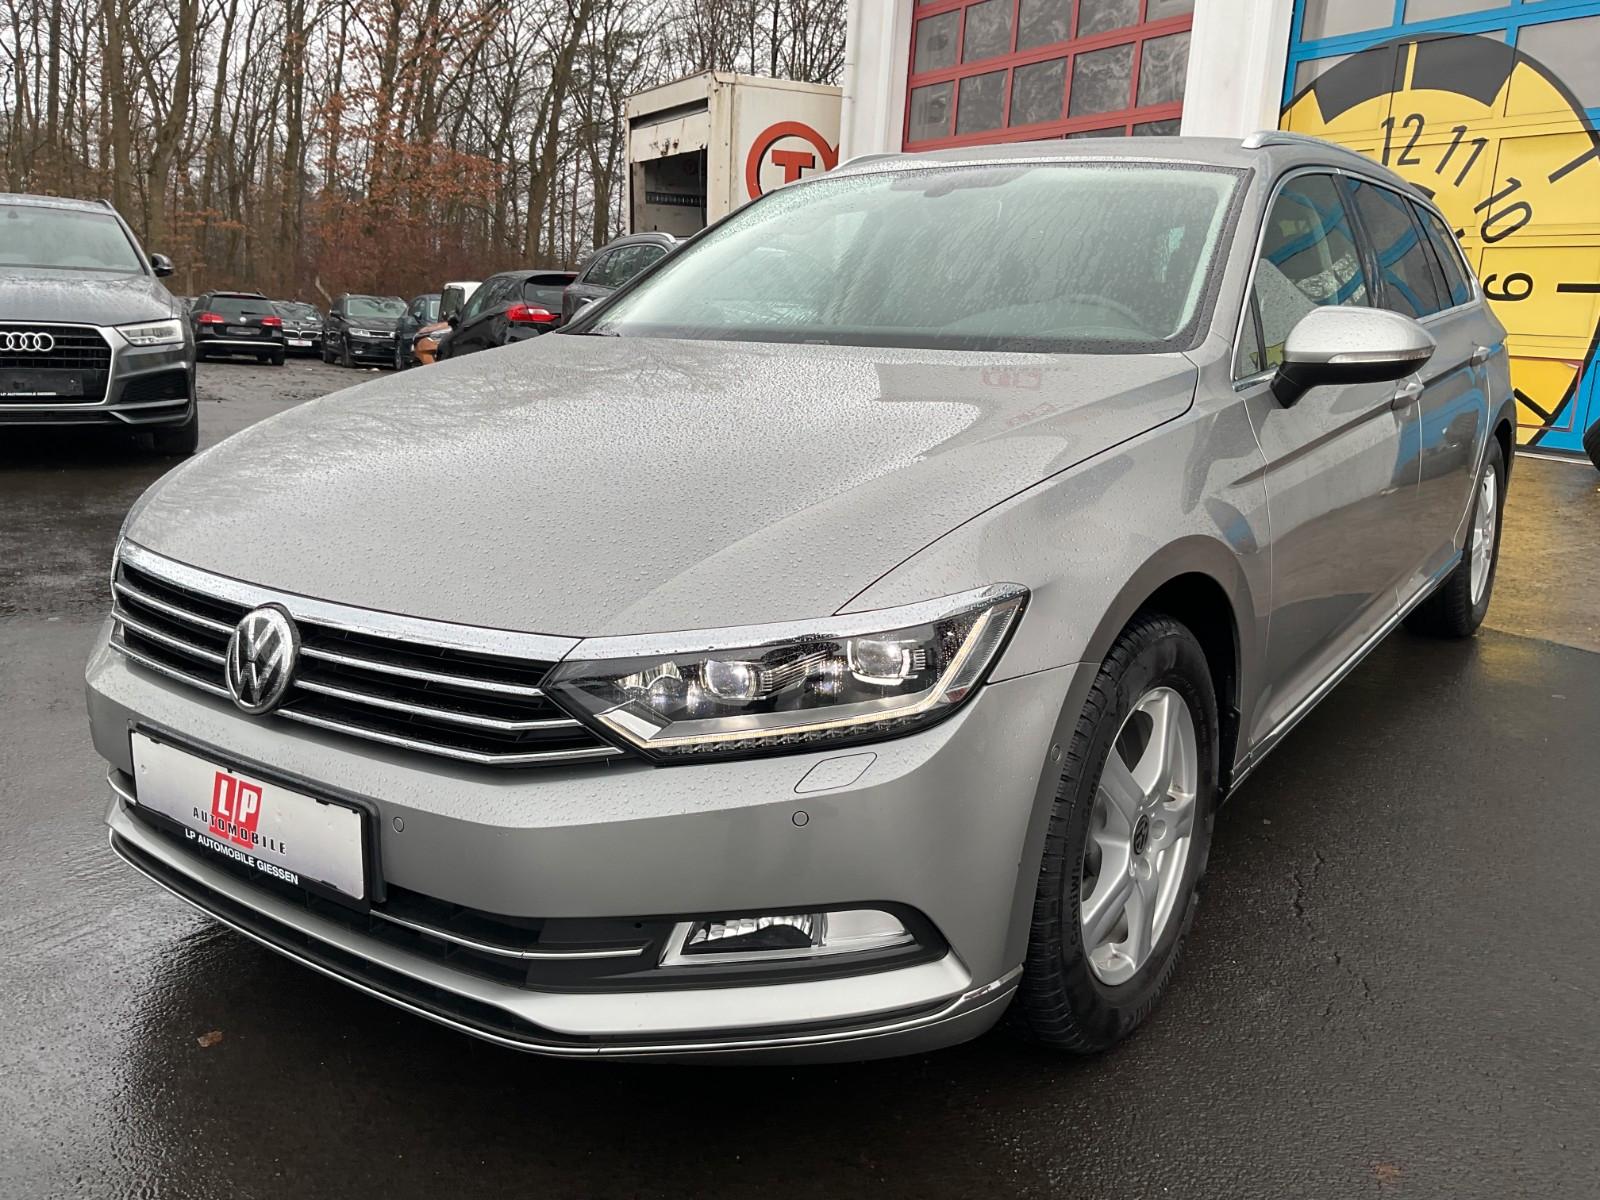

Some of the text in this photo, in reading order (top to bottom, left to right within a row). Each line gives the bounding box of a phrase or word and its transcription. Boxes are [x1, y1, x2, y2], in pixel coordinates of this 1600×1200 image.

[1380, 113, 1425, 167] 12
[1435, 125, 1490, 188] 11
[1473, 176, 1533, 244] 10
[217, 778, 259, 823] LP
[185, 828, 299, 885] LP AUTOMOBILE GIESSEN
[193, 807, 287, 855] AUTOMOBILE
